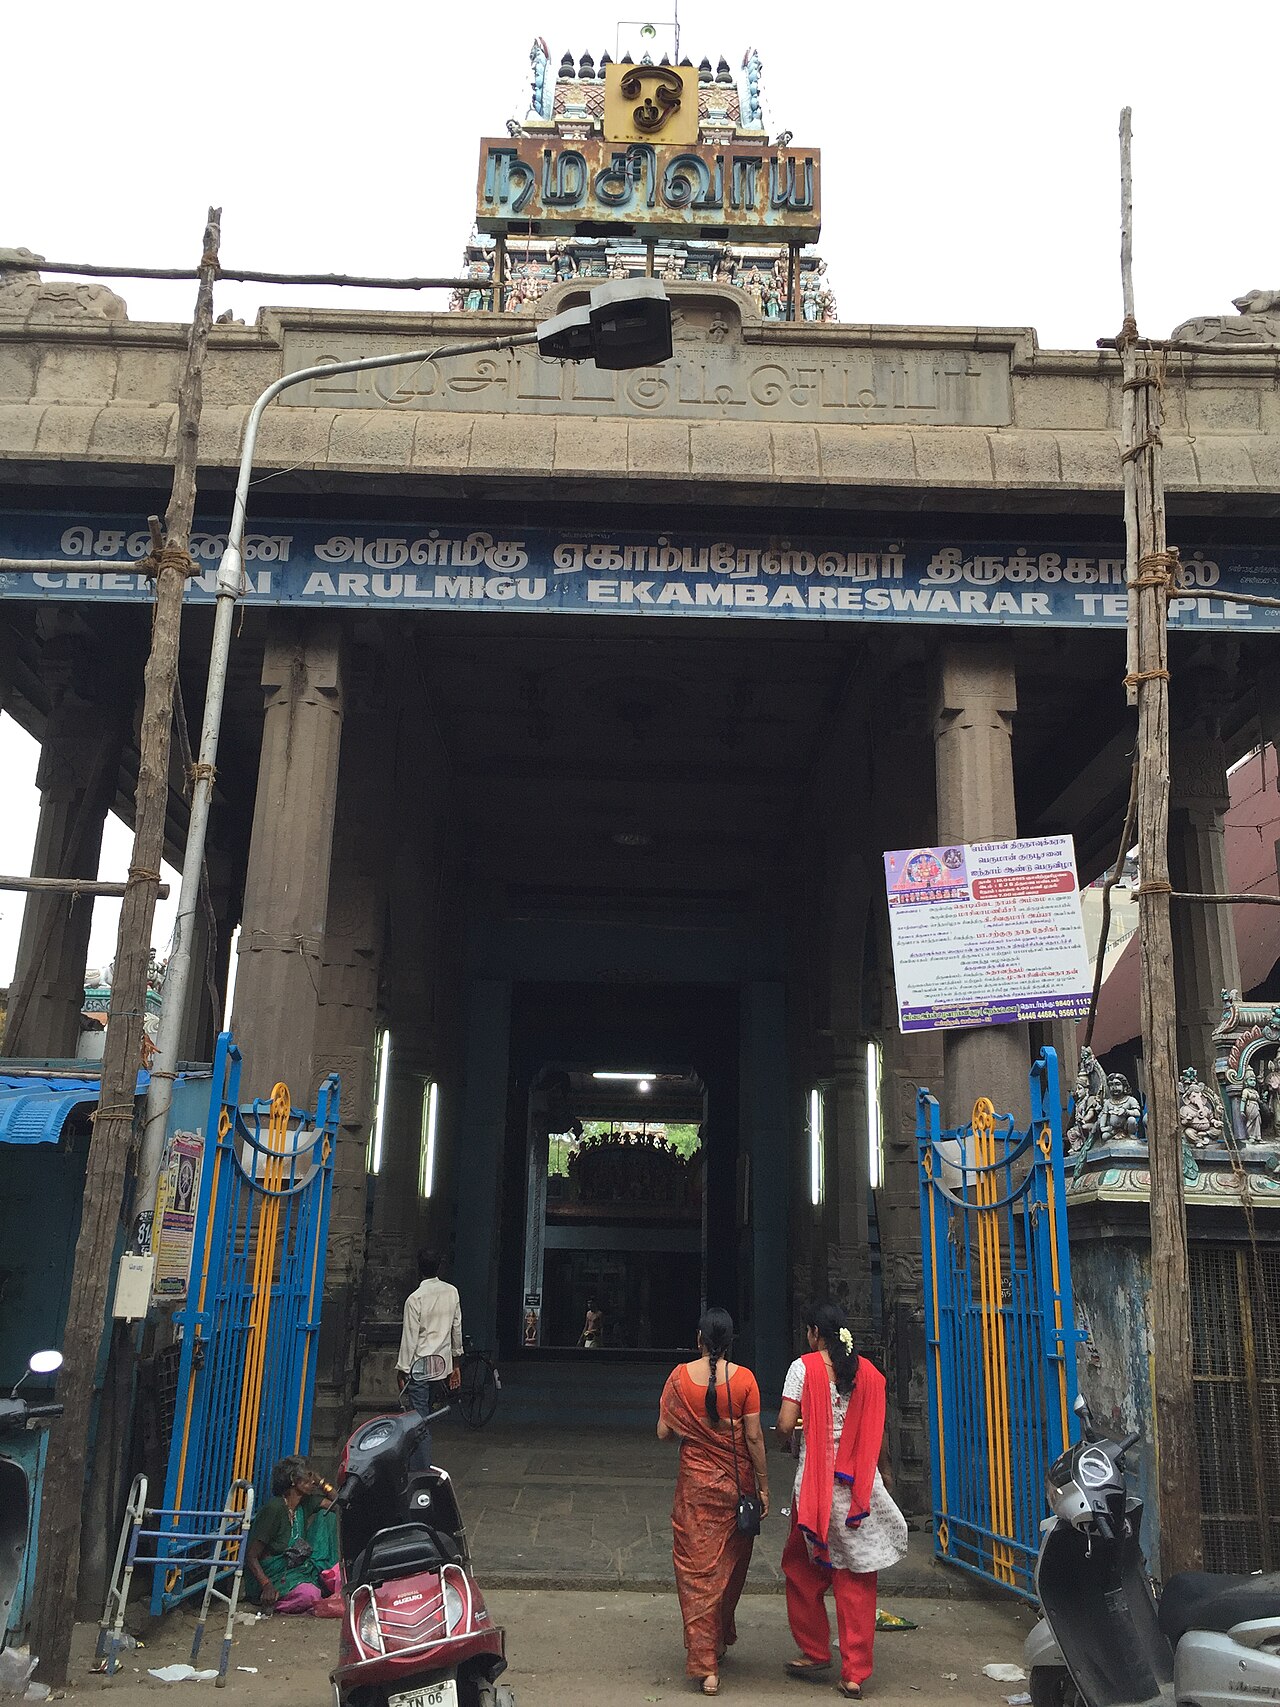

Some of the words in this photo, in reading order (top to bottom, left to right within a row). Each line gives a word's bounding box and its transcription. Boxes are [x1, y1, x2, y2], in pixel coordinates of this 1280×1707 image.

[484, 144, 813, 213] நமசிவாய
[314, 529, 529, 573] அருள்மிகு
[553, 536, 905, 582] ஏகாம்பரேஸ்வரர்
[302, 572, 547, 600] ARULMIGU
[587, 579, 1053, 615] EKAMBARESWARAR
[1074, 594, 1253, 619] TEPLE
[393, 1593, 423, 1607] SUZUKI
[428, 1692, 443, 1705] 06
